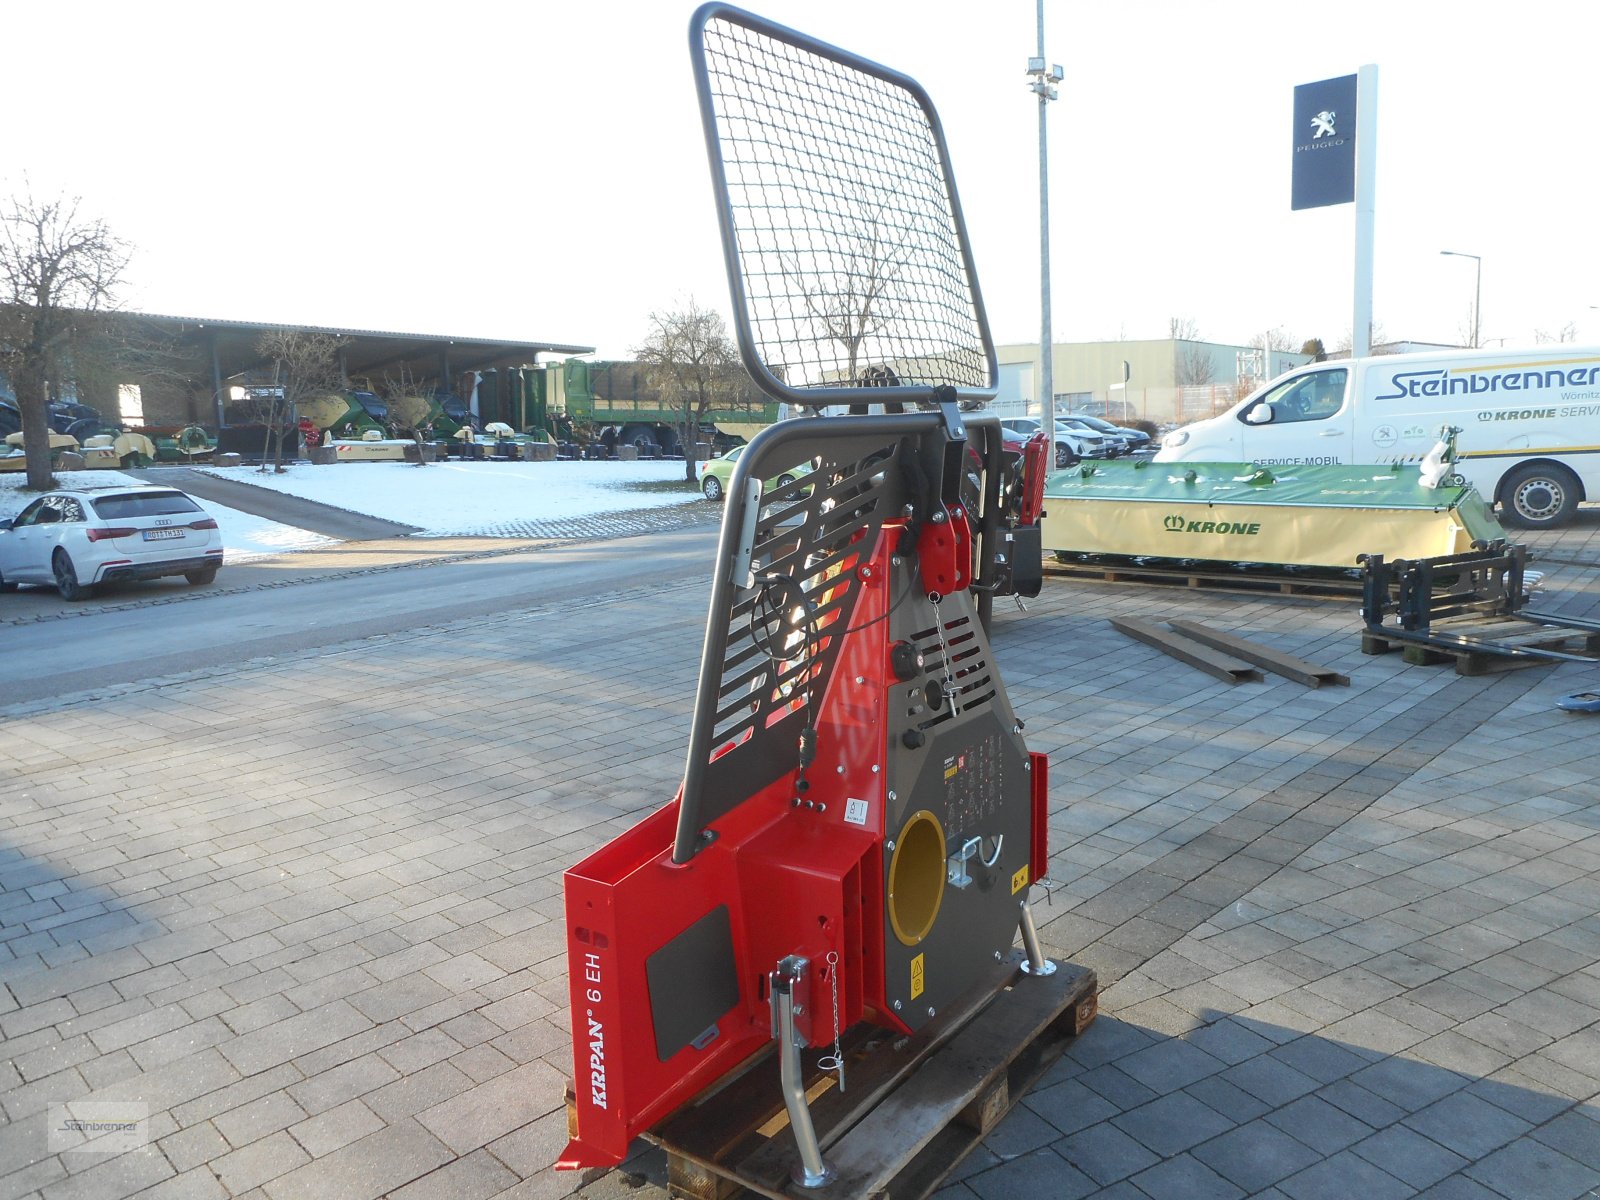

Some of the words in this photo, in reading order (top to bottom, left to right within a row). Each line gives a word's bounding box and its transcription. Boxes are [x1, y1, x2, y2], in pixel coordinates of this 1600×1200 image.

[1374, 367, 1600, 400] Steinbrenner
[1494, 408, 1557, 421] KRONE
[1253, 456, 1342, 465] SERVICE-MOBIL
[1186, 521, 1261, 535] KRONE
[585, 953, 601, 983] EH
[586, 988, 602, 1002] 6
